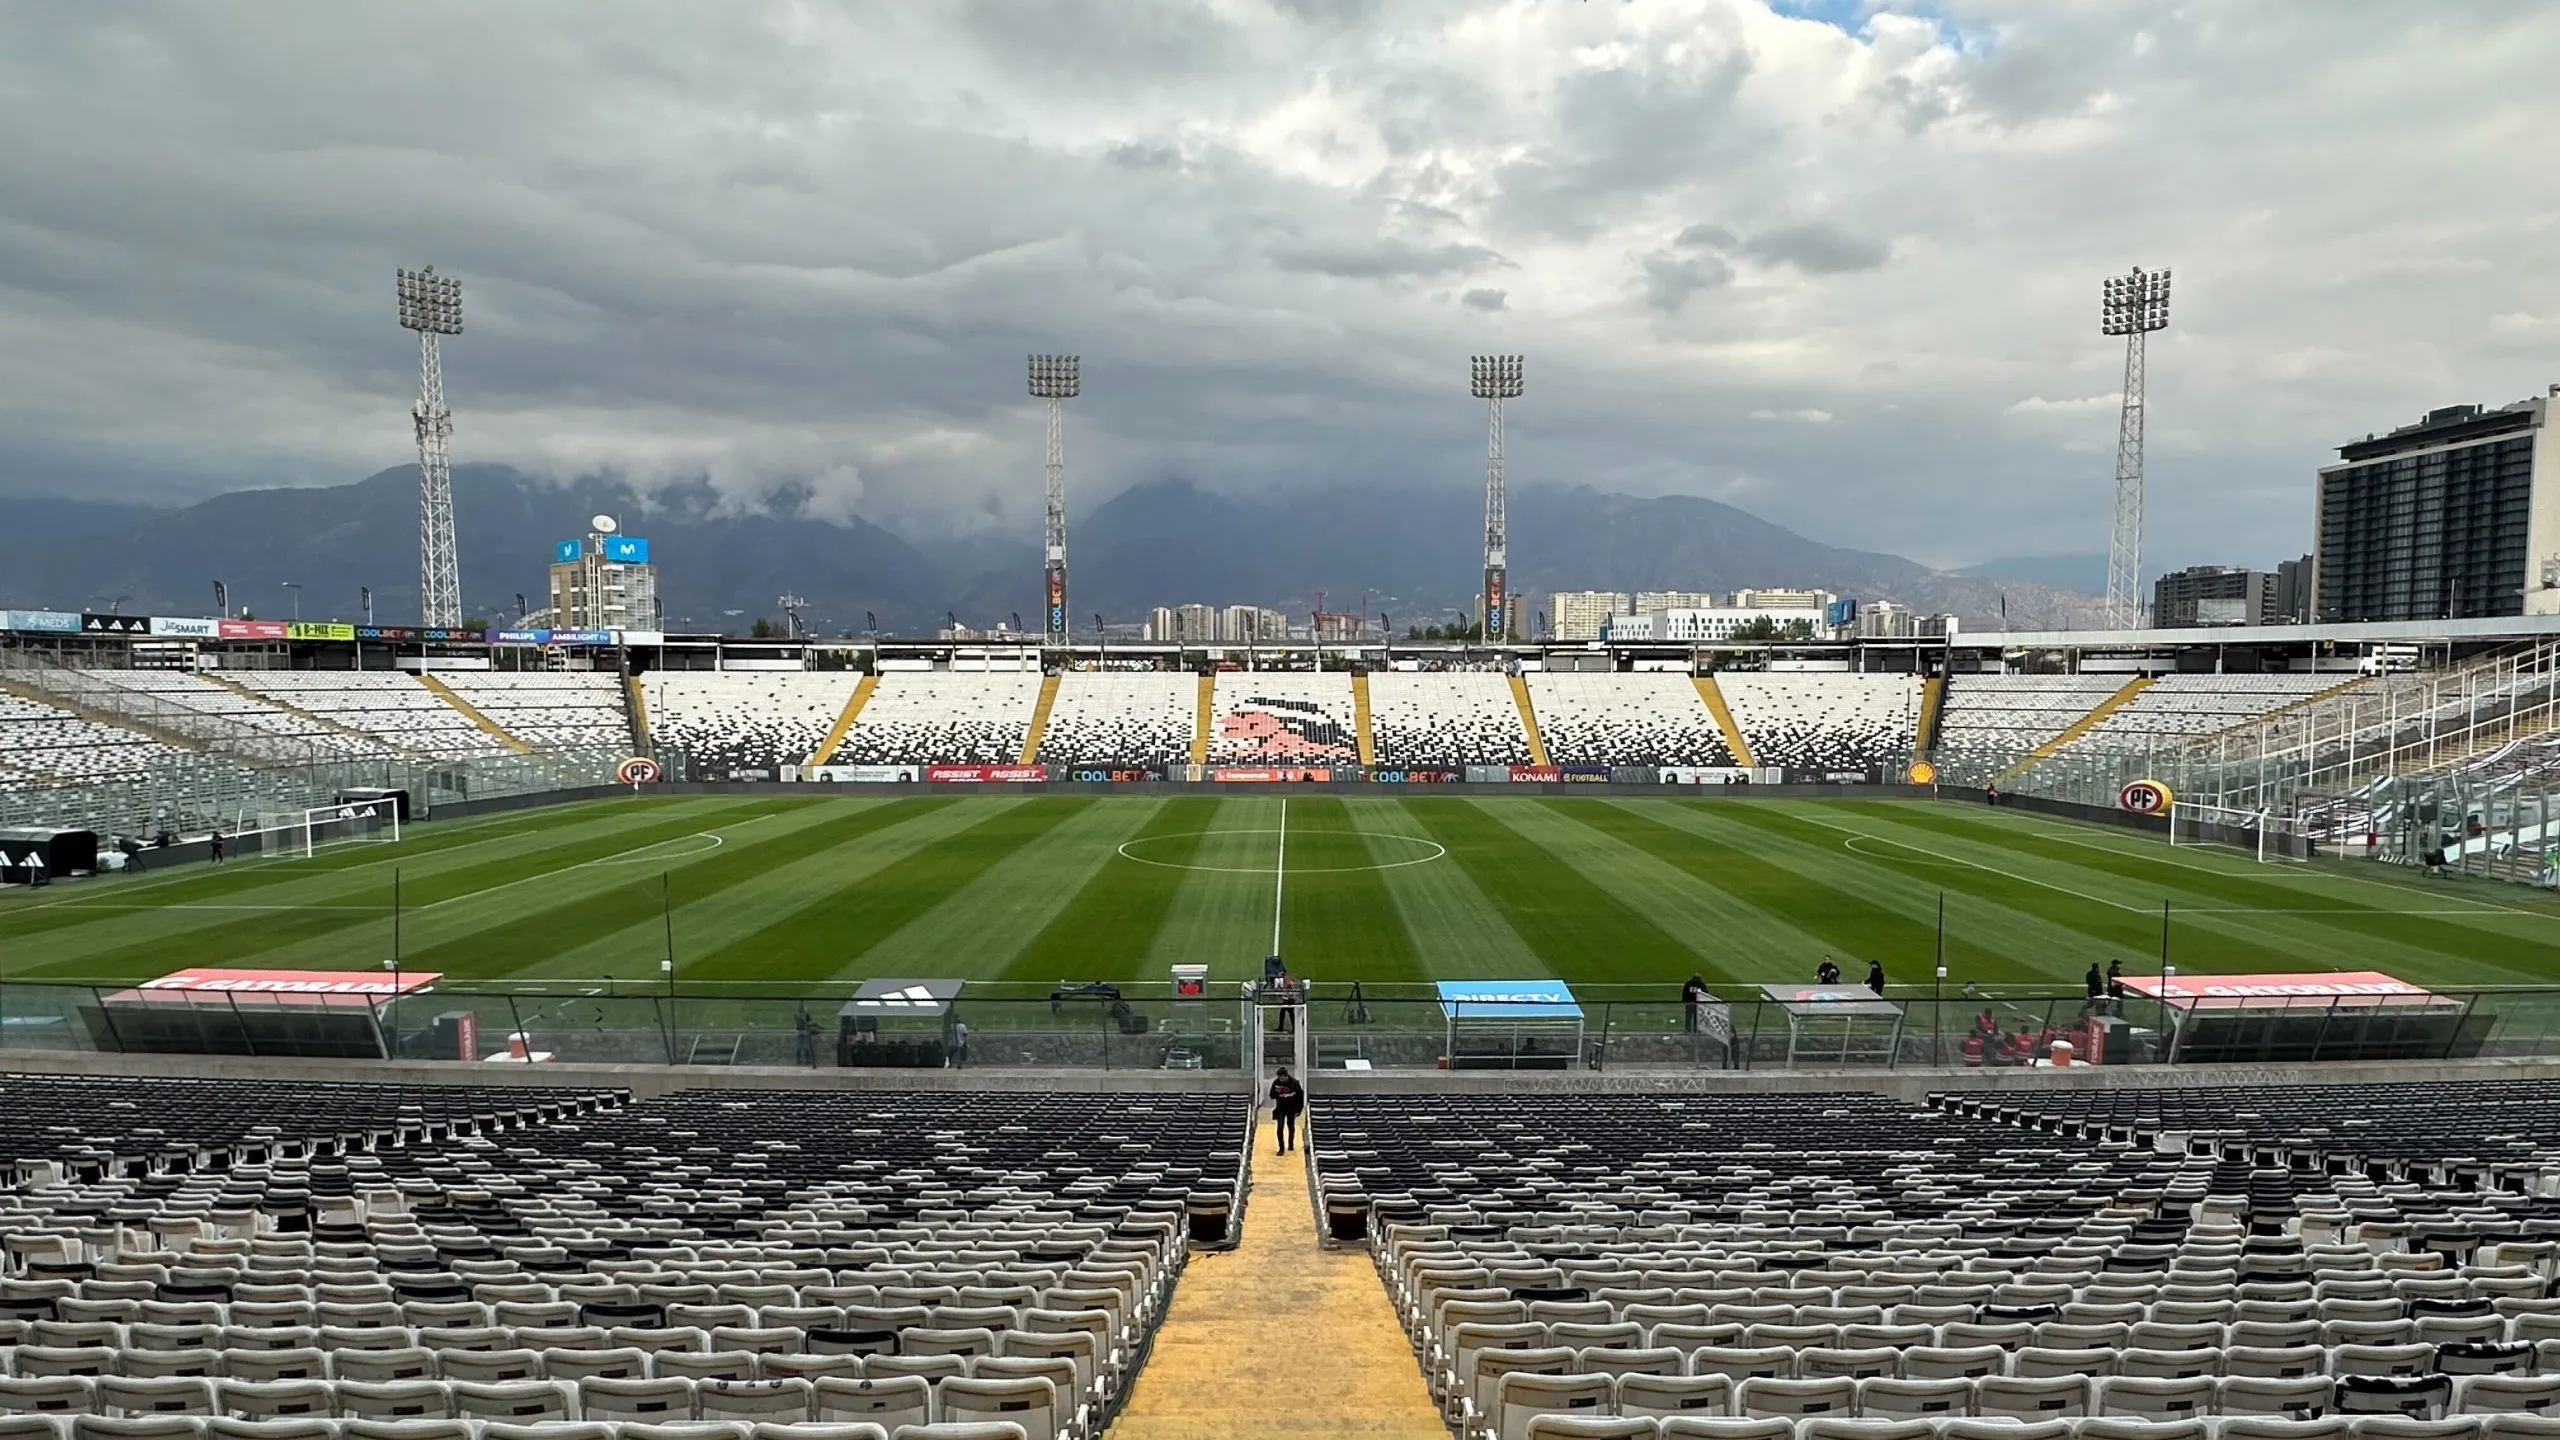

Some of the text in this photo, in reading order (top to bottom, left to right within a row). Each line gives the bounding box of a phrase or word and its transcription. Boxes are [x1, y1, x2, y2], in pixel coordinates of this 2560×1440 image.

[1052, 583, 1062, 632] COOLBET
[1491, 586, 1501, 634] COOLBET
[40, 617, 70, 629] MEDS
[304, 624, 329, 635] B-MIX
[499, 632, 536, 641] PHILIPS
[552, 632, 598, 641] AMBILIGHT
[630, 764, 650, 780] PF
[932, 769, 982, 779] ASSIST
[990, 769, 1039, 779] ASSIST
[1072, 770, 1141, 782] COOLBET
[1370, 771, 1437, 782] COOLBET
[1512, 773, 1557, 782] KONAMI
[2130, 788, 2154, 808] PF
[1452, 993, 1561, 1002] DIRECTV
